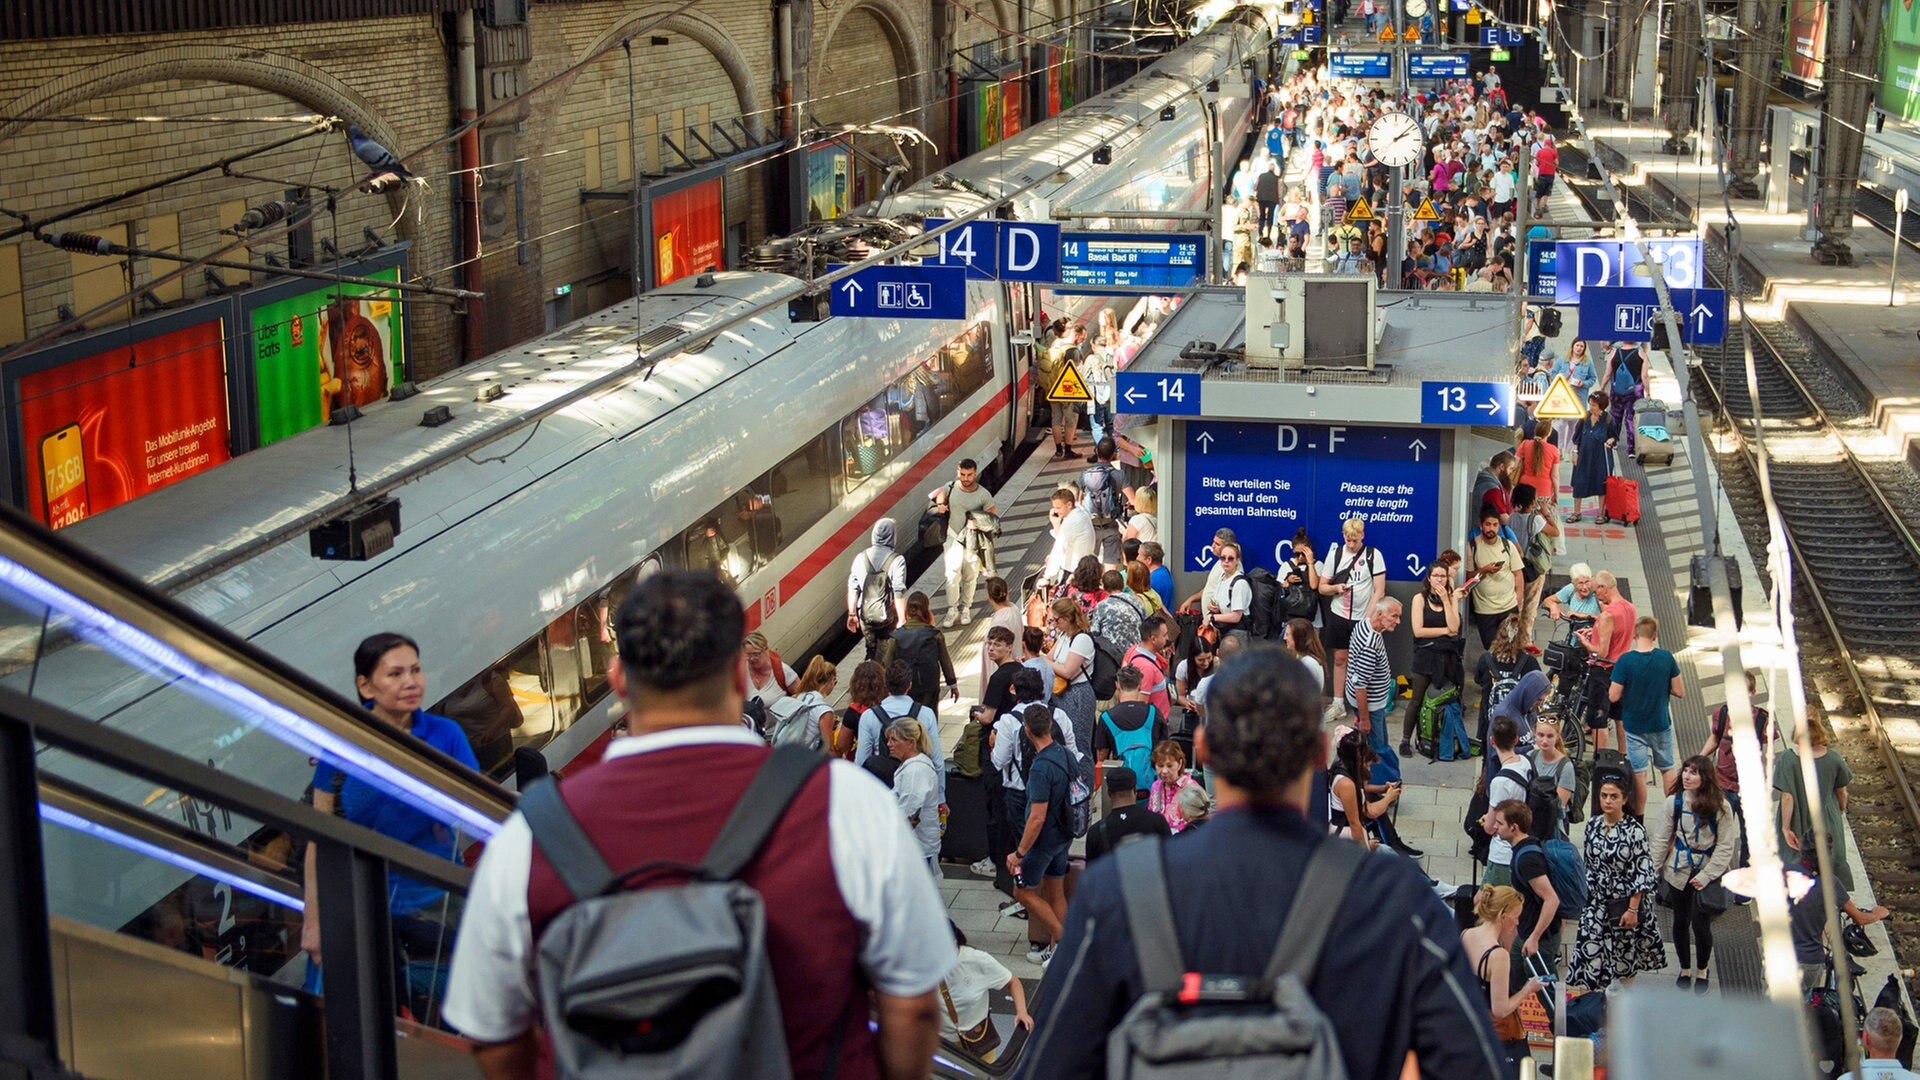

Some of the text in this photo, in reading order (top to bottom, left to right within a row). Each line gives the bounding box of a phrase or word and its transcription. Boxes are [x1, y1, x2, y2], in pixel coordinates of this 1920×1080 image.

[1304, 28, 1313, 41] E
[1487, 29, 1497, 43] E
[940, 226, 1040, 272] 14 D
[1062, 242, 1078, 257] 14
[1088, 253, 1138, 262] Basel Bad Bf
[1576, 247, 1610, 292] D
[257, 324, 279, 341] Uber
[259, 342, 280, 359] Eats
[1157, 378, 1184, 402] 14
[1437, 387, 1466, 412] 13
[145, 416, 217, 453] Das Mobilfunk-Angebot
[1278, 425, 1298, 451] D
[1329, 427, 1347, 453] F
[146, 440, 200, 469] für unsere treuen
[1202, 477, 1290, 490] Bitte verteilen Sie
[1340, 482, 1414, 495] Please use the
[1214, 492, 1278, 503] sich auf dem
[1344, 497, 1408, 510] entire length
[1195, 506, 1297, 520] gesamten Bahnsteig
[1339, 510, 1413, 523] of the platform
[214, 881, 236, 936] 2
